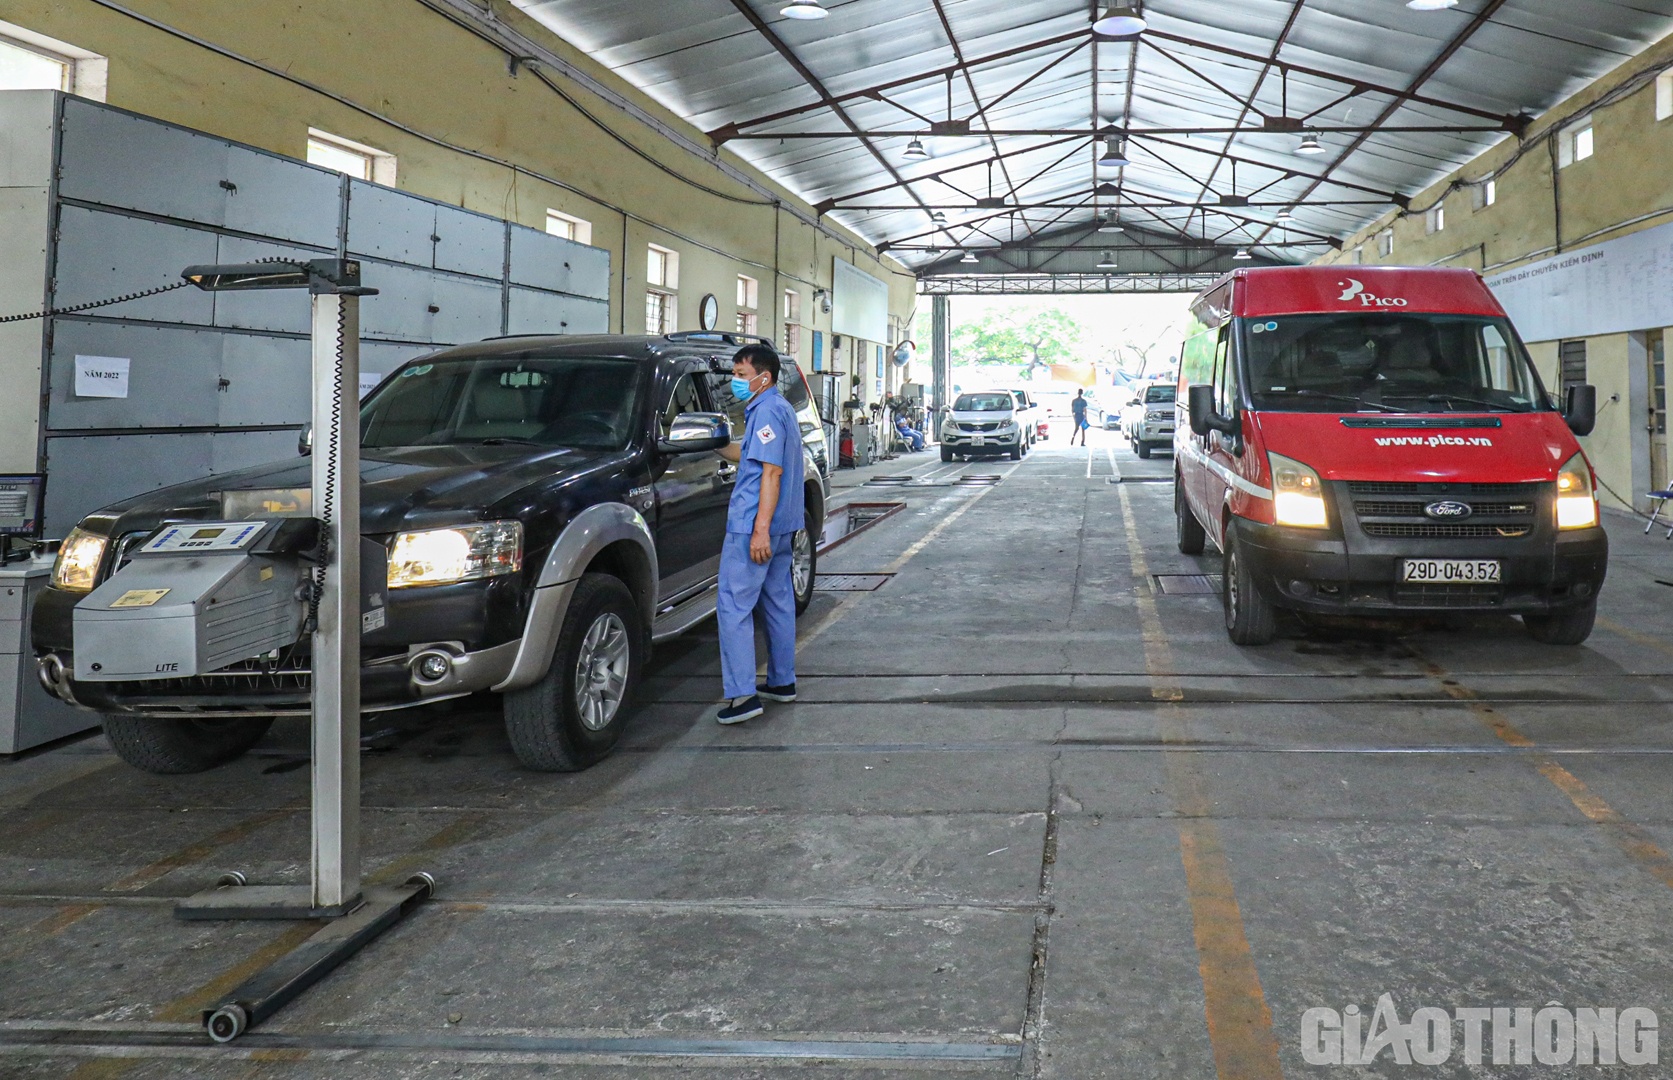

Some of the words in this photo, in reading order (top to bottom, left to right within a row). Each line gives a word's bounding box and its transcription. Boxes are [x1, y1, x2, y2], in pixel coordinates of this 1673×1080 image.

[1581, 251, 1604, 264] ĐỊNH
[84, 370, 102, 378] NĂM
[1374, 434, 1493, 448] www.pico.vn
[1436, 504, 1462, 515] Ford
[1407, 562, 1497, 580] 29D-043.52
[155, 663, 179, 672] LITE
